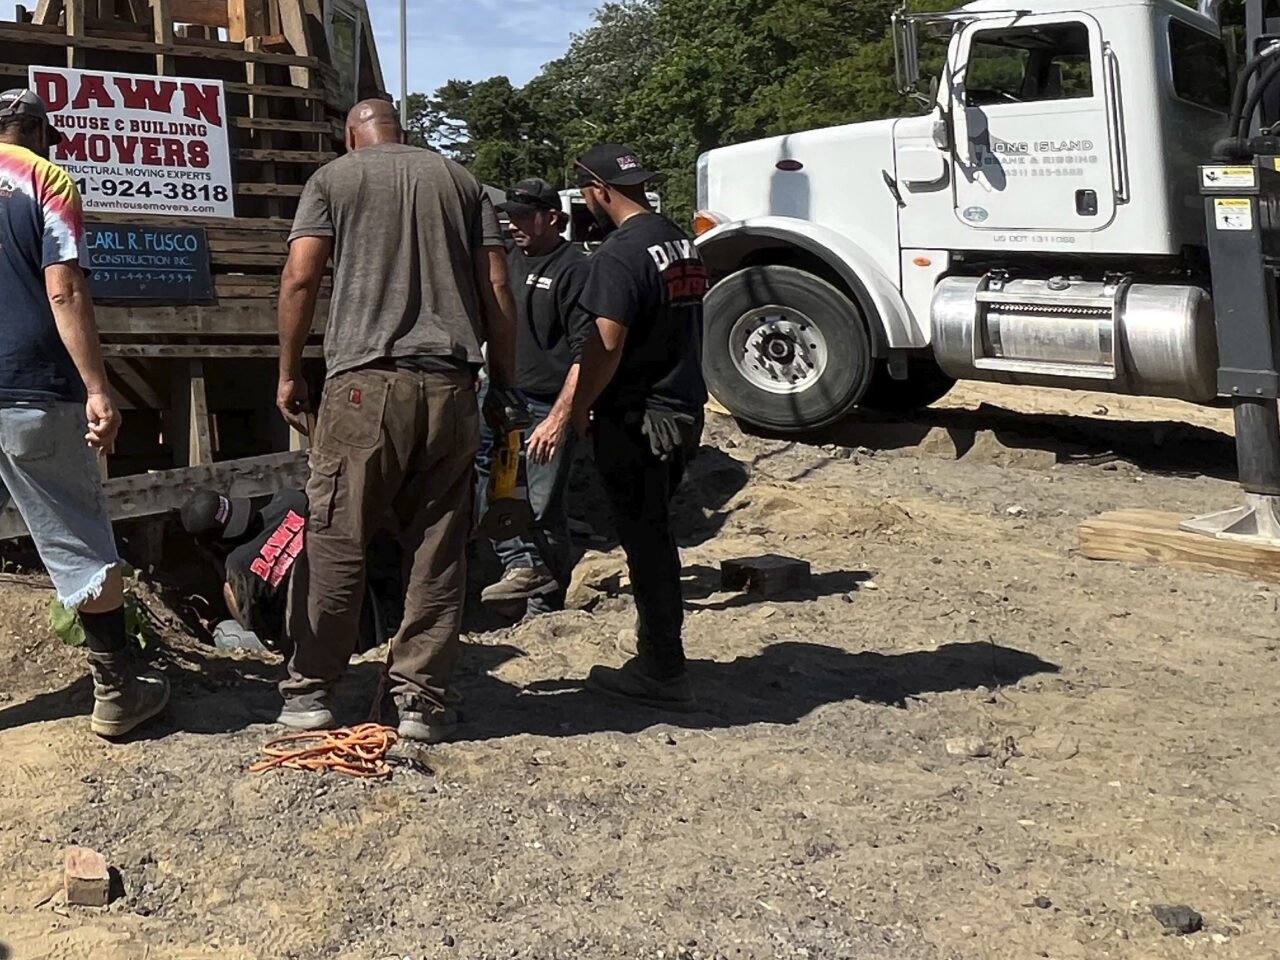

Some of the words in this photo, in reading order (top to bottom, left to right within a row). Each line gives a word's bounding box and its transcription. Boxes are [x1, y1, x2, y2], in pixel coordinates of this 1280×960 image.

[33, 71, 222, 127] DAWN
[54, 114, 109, 130] HOUSE
[130, 120, 207, 137] BUILDING
[55, 132, 210, 169] MOVERS
[990, 141, 1029, 153] ONG
[1034, 140, 1093, 152] ISLAND
[55, 164, 123, 176] TRUCTURAL
[125, 168, 164, 179] MOVING
[167, 170, 211, 181] EXPERTS
[86, 231, 124, 250] CARL
[144, 233, 198, 252] FUSCO
[91, 253, 170, 265] CONSTRUCTION
[250, 509, 305, 582] DAWN
